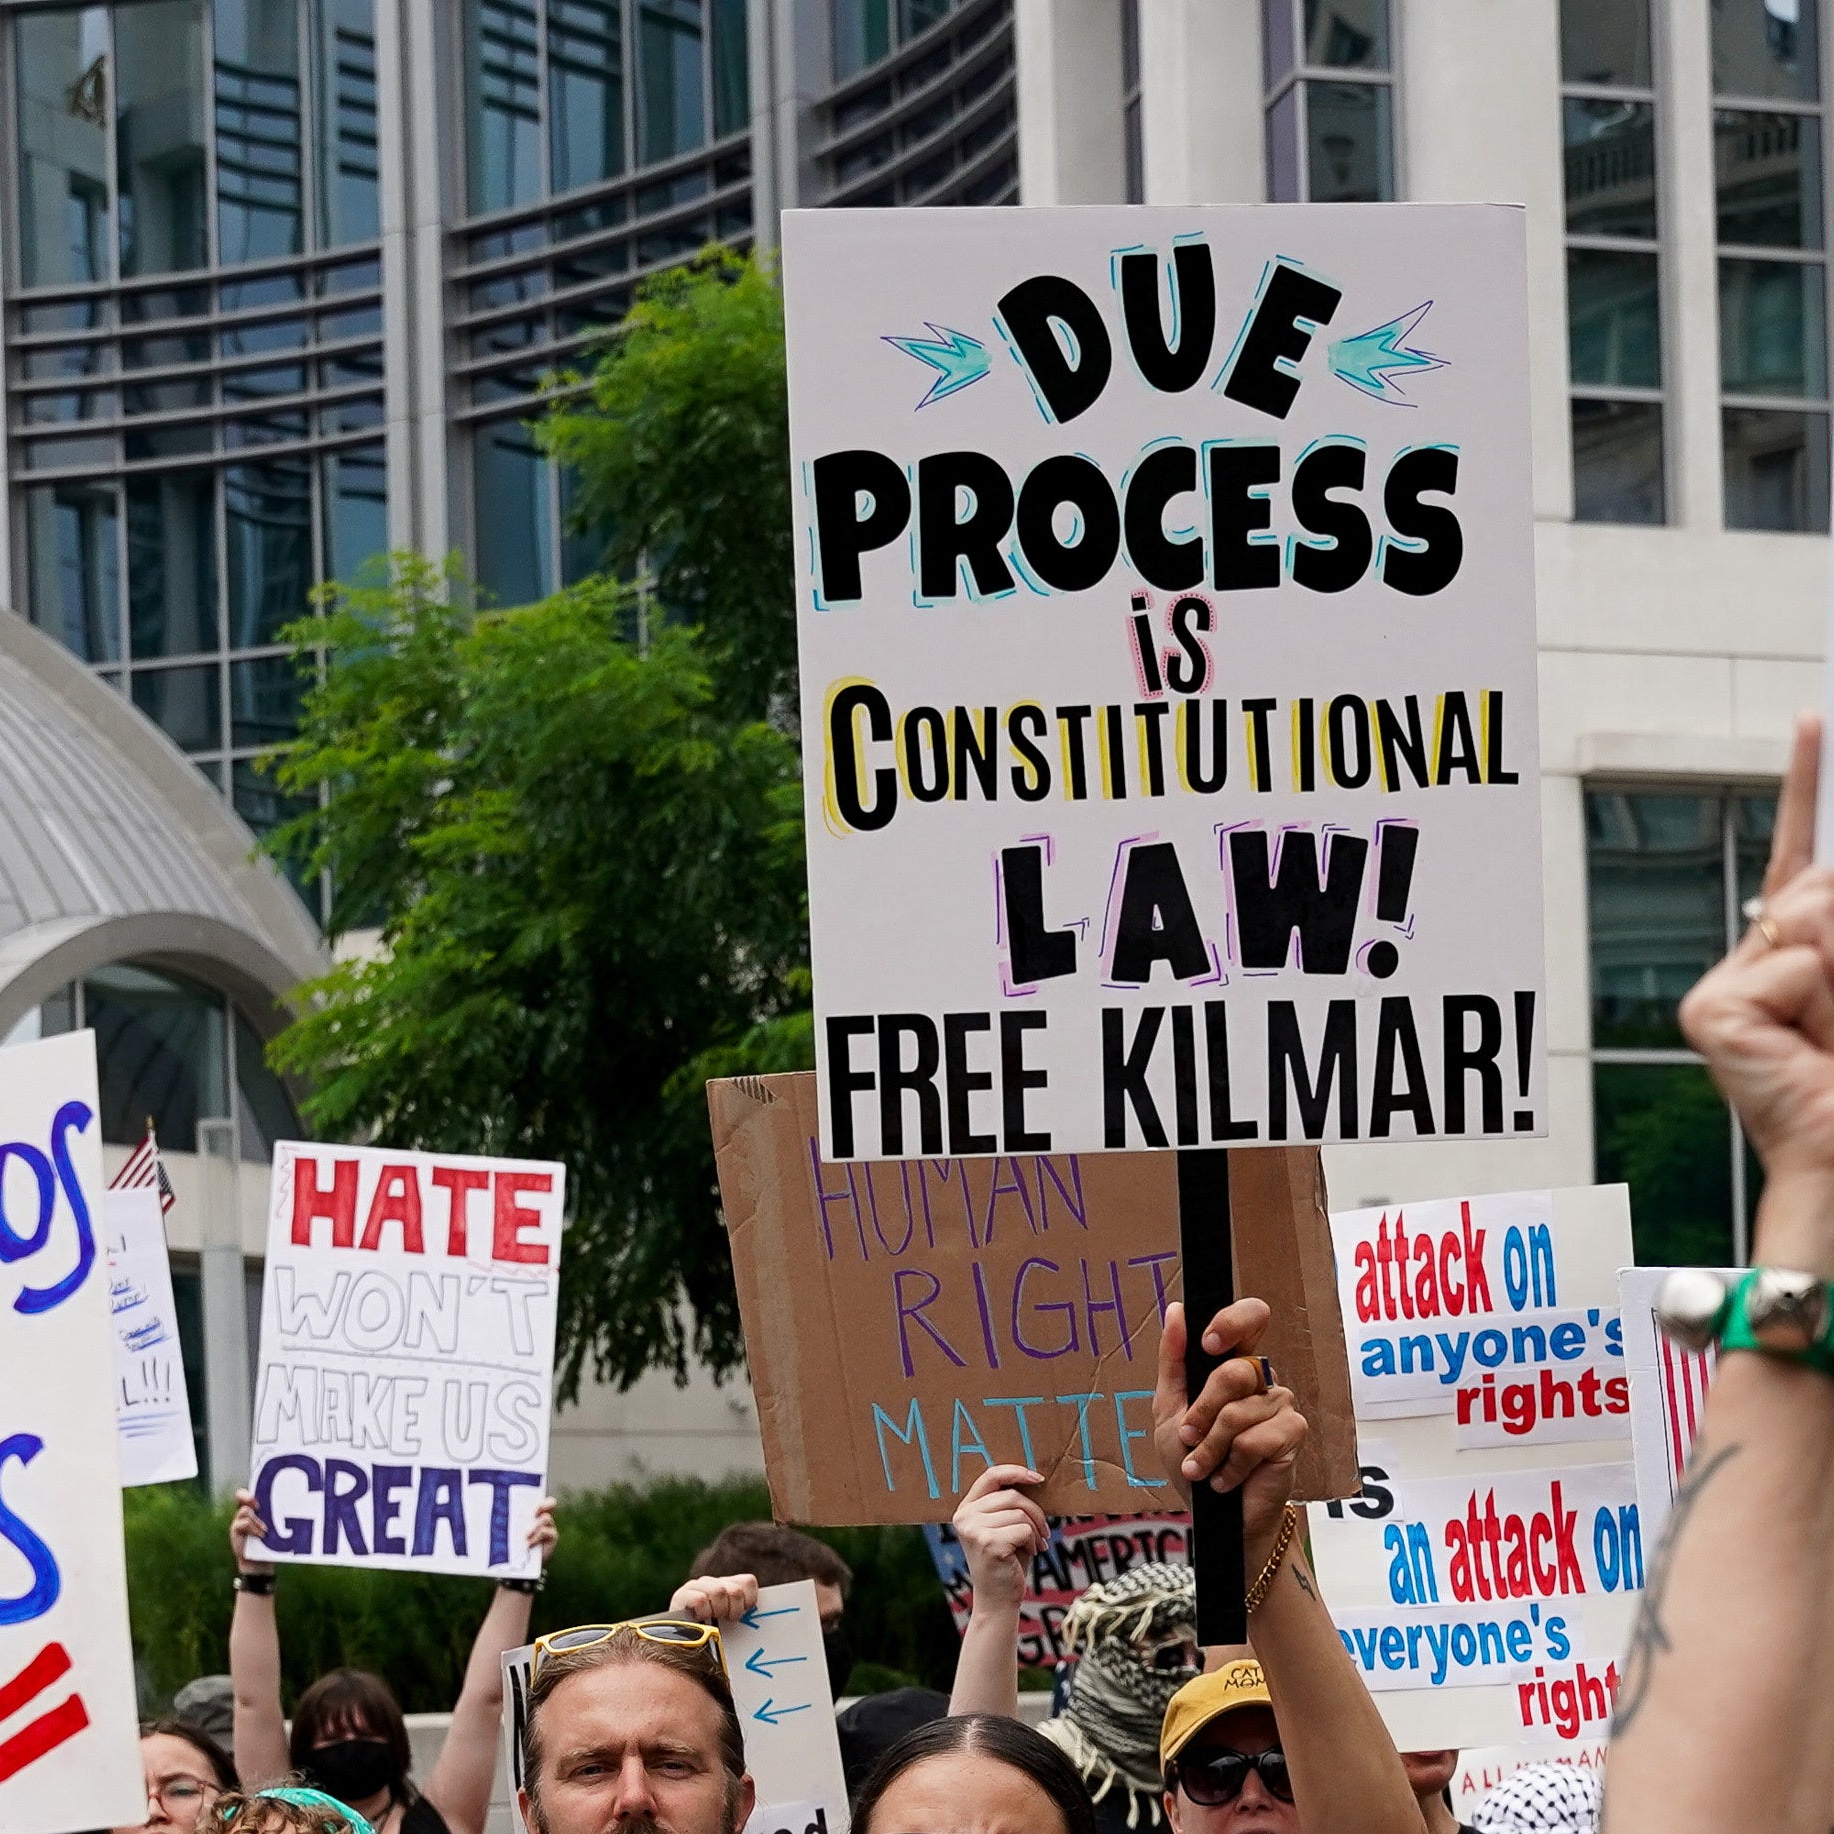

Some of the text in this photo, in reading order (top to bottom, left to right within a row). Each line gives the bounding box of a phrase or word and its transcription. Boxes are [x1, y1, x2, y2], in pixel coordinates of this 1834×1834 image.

[994, 238, 1343, 424] DUE
[810, 441, 1463, 606] PROCESS
[1133, 592, 1214, 695] is
[998, 826, 1421, 988] LAW!
[824, 991, 1537, 1159] FREE KILMAR!
[290, 1158, 554, 1265] HATE
[809, 1135, 1089, 1262] HUMAN
[274, 1265, 549, 1355] WON'T
[891, 1252, 1178, 1379] RIGHT
[1354, 1201, 1557, 1323] attack on
[255, 1363, 542, 1463] MAKE US
[871, 1390, 1169, 1501] MATTE
[1455, 1367, 1630, 1436] rights
[254, 1453, 542, 1568] GREAT
[1384, 1481, 1645, 1605] an attack on
[1230, 1666, 1261, 1679] CAT
